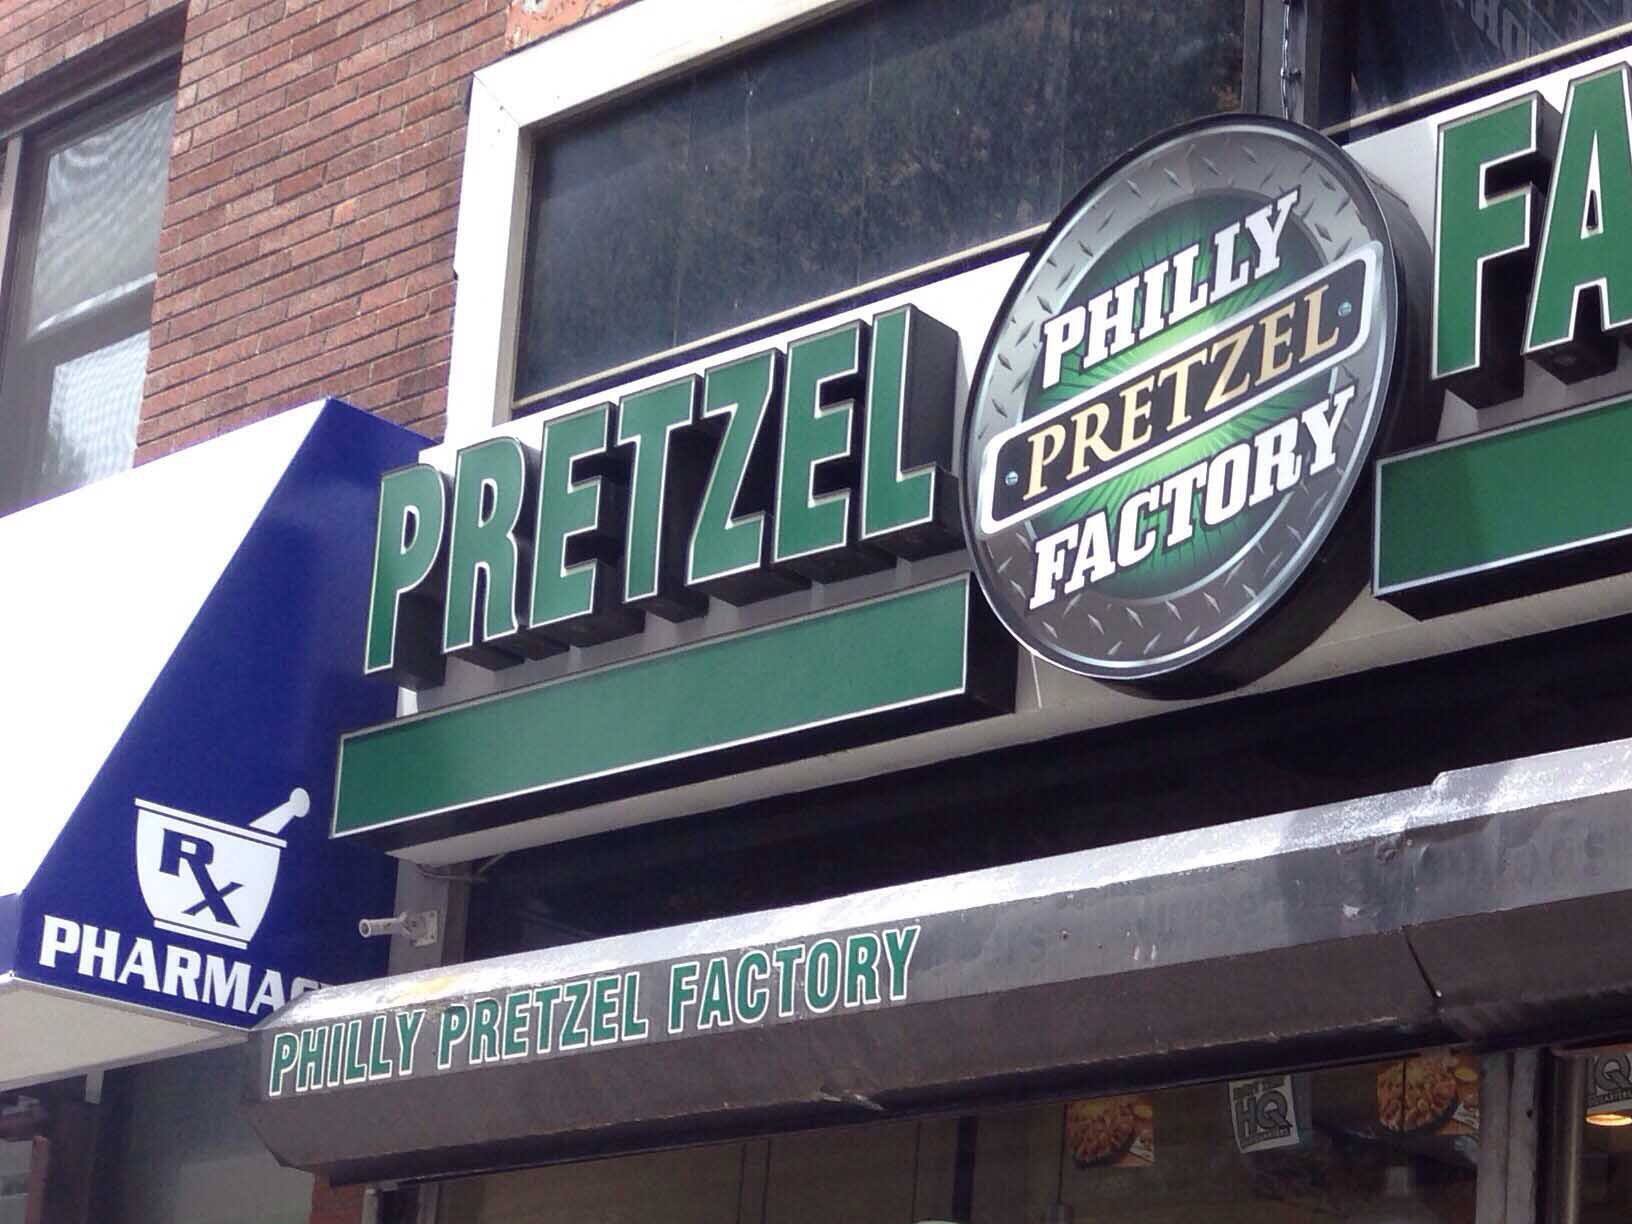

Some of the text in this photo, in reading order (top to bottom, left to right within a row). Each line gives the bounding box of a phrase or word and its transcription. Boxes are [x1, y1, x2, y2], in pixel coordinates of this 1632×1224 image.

[1023, 285, 1340, 502] PRETZEL
[1041, 189, 1299, 390] PHILLY
[364, 304, 936, 675] PRETZEL
[1028, 389, 1355, 610] FACTORY
[39, 914, 332, 1016] PHARMA
[268, 925, 922, 1098] PHILLY PRETZEL FACTORY
